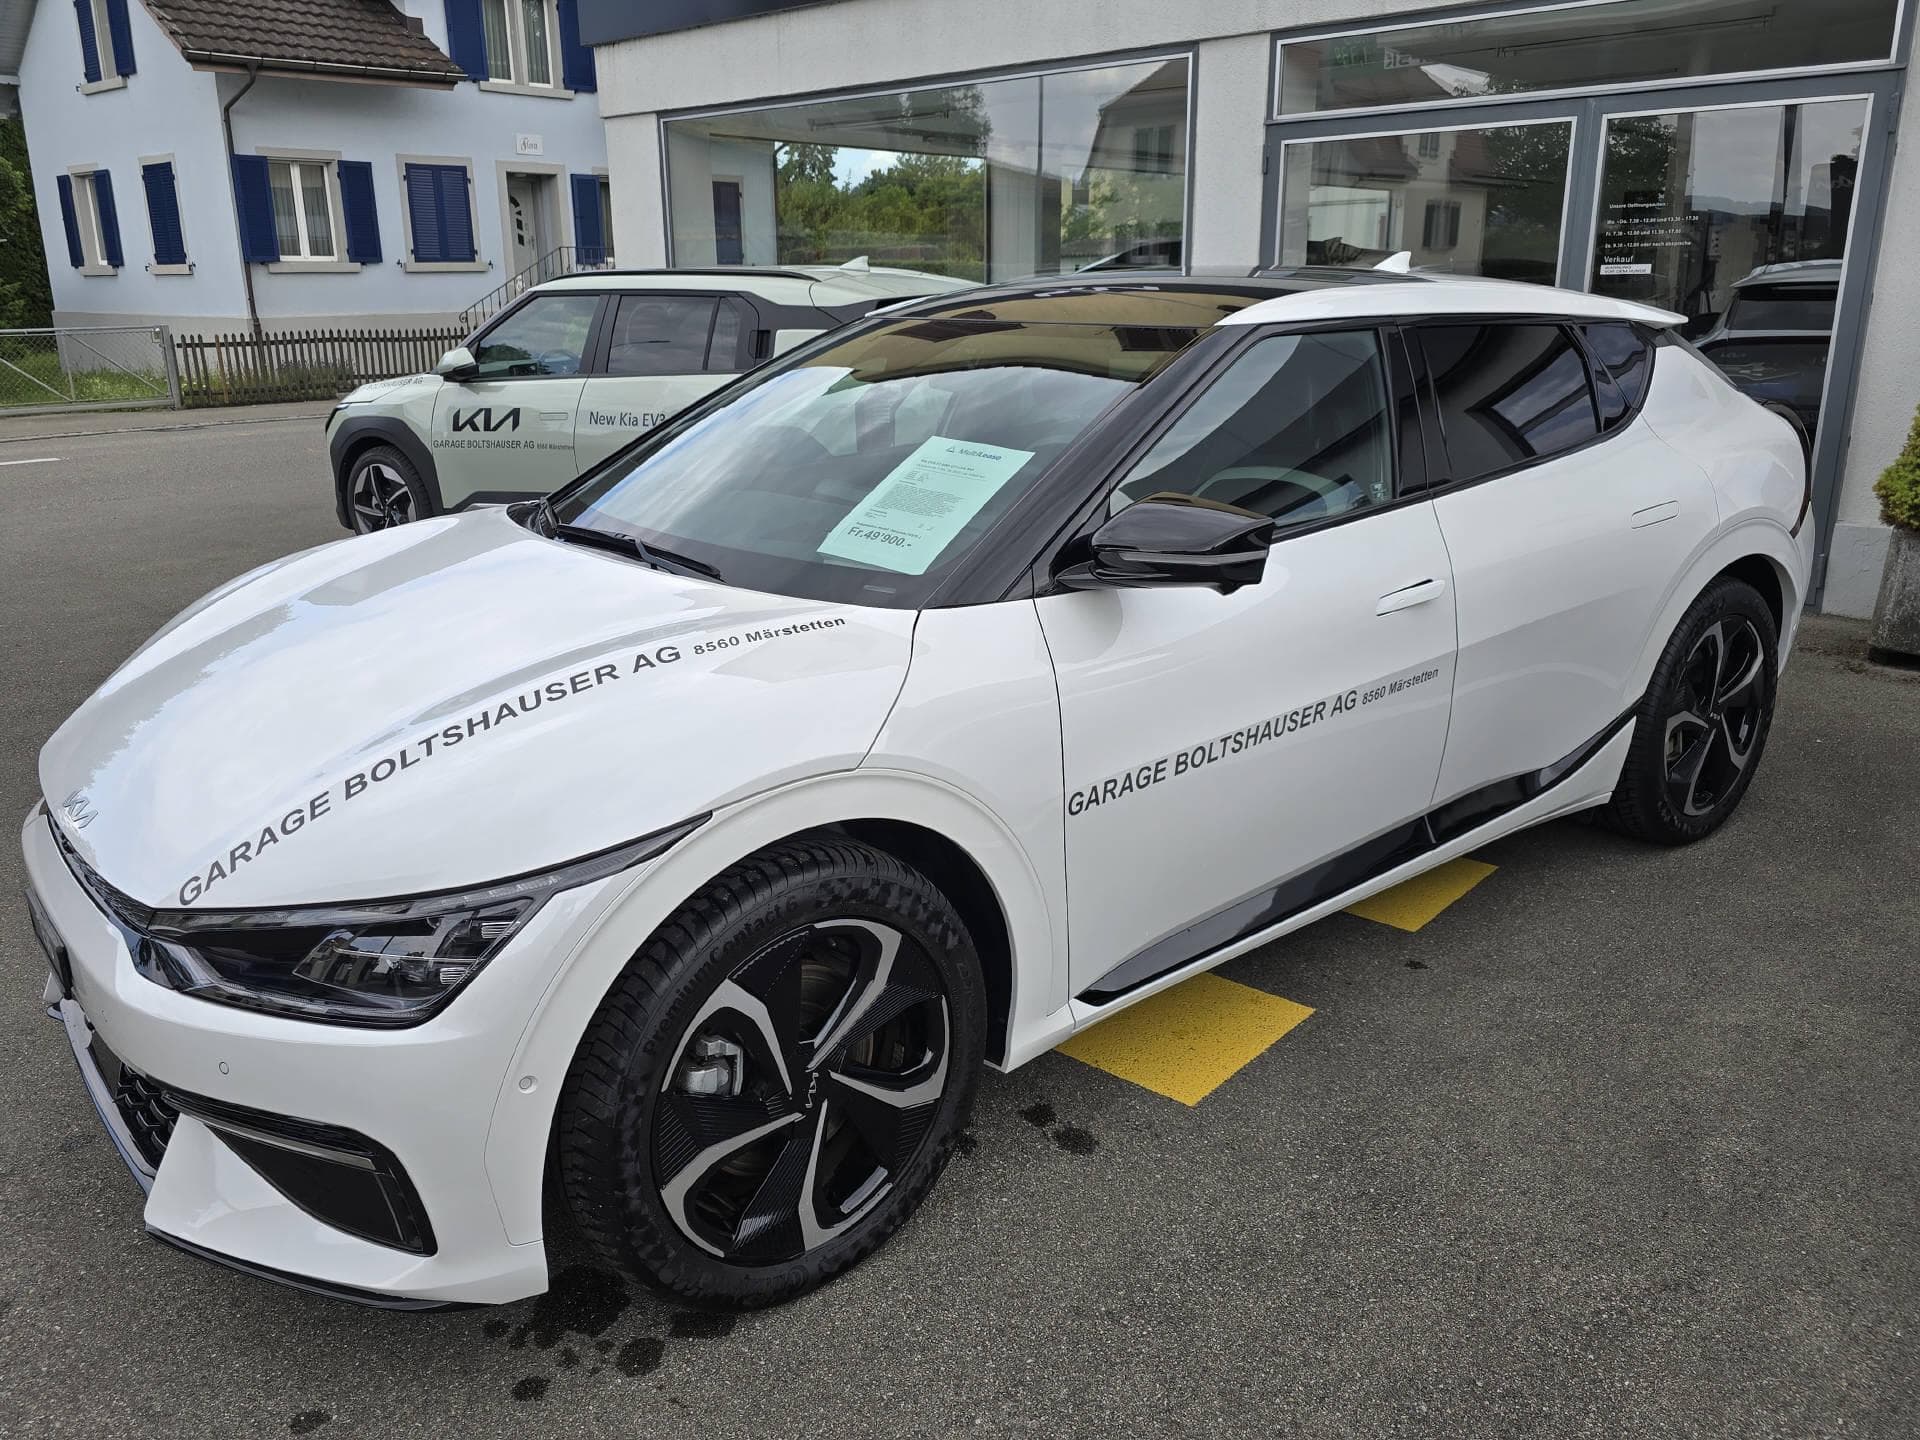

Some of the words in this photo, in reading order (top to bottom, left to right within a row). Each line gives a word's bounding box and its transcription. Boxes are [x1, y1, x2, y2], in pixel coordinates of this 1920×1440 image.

[1604, 255, 1634, 263] Verkauf
[452, 407, 521, 432] KIA
[589, 411, 616, 425] New
[620, 412, 639, 427] Kia
[433, 440, 466, 449] GARAGE
[467, 440, 521, 449] BOLTSHAUSER
[523, 440, 535, 449] AG
[1067, 758, 1168, 816] GARAGE
[1173, 700, 1327, 777] BOLTSHAUSER
[1330, 690, 1358, 718] AG
[1361, 686, 1387, 706] 8560
[1388, 668, 1439, 695] Märstetten
[177, 790, 332, 907] GARAGE
[343, 663, 622, 798] BOLTSHAUSER
[632, 645, 682, 673] AG
[692, 634, 740, 656] 8560
[745, 615, 847, 642] Märstetten
